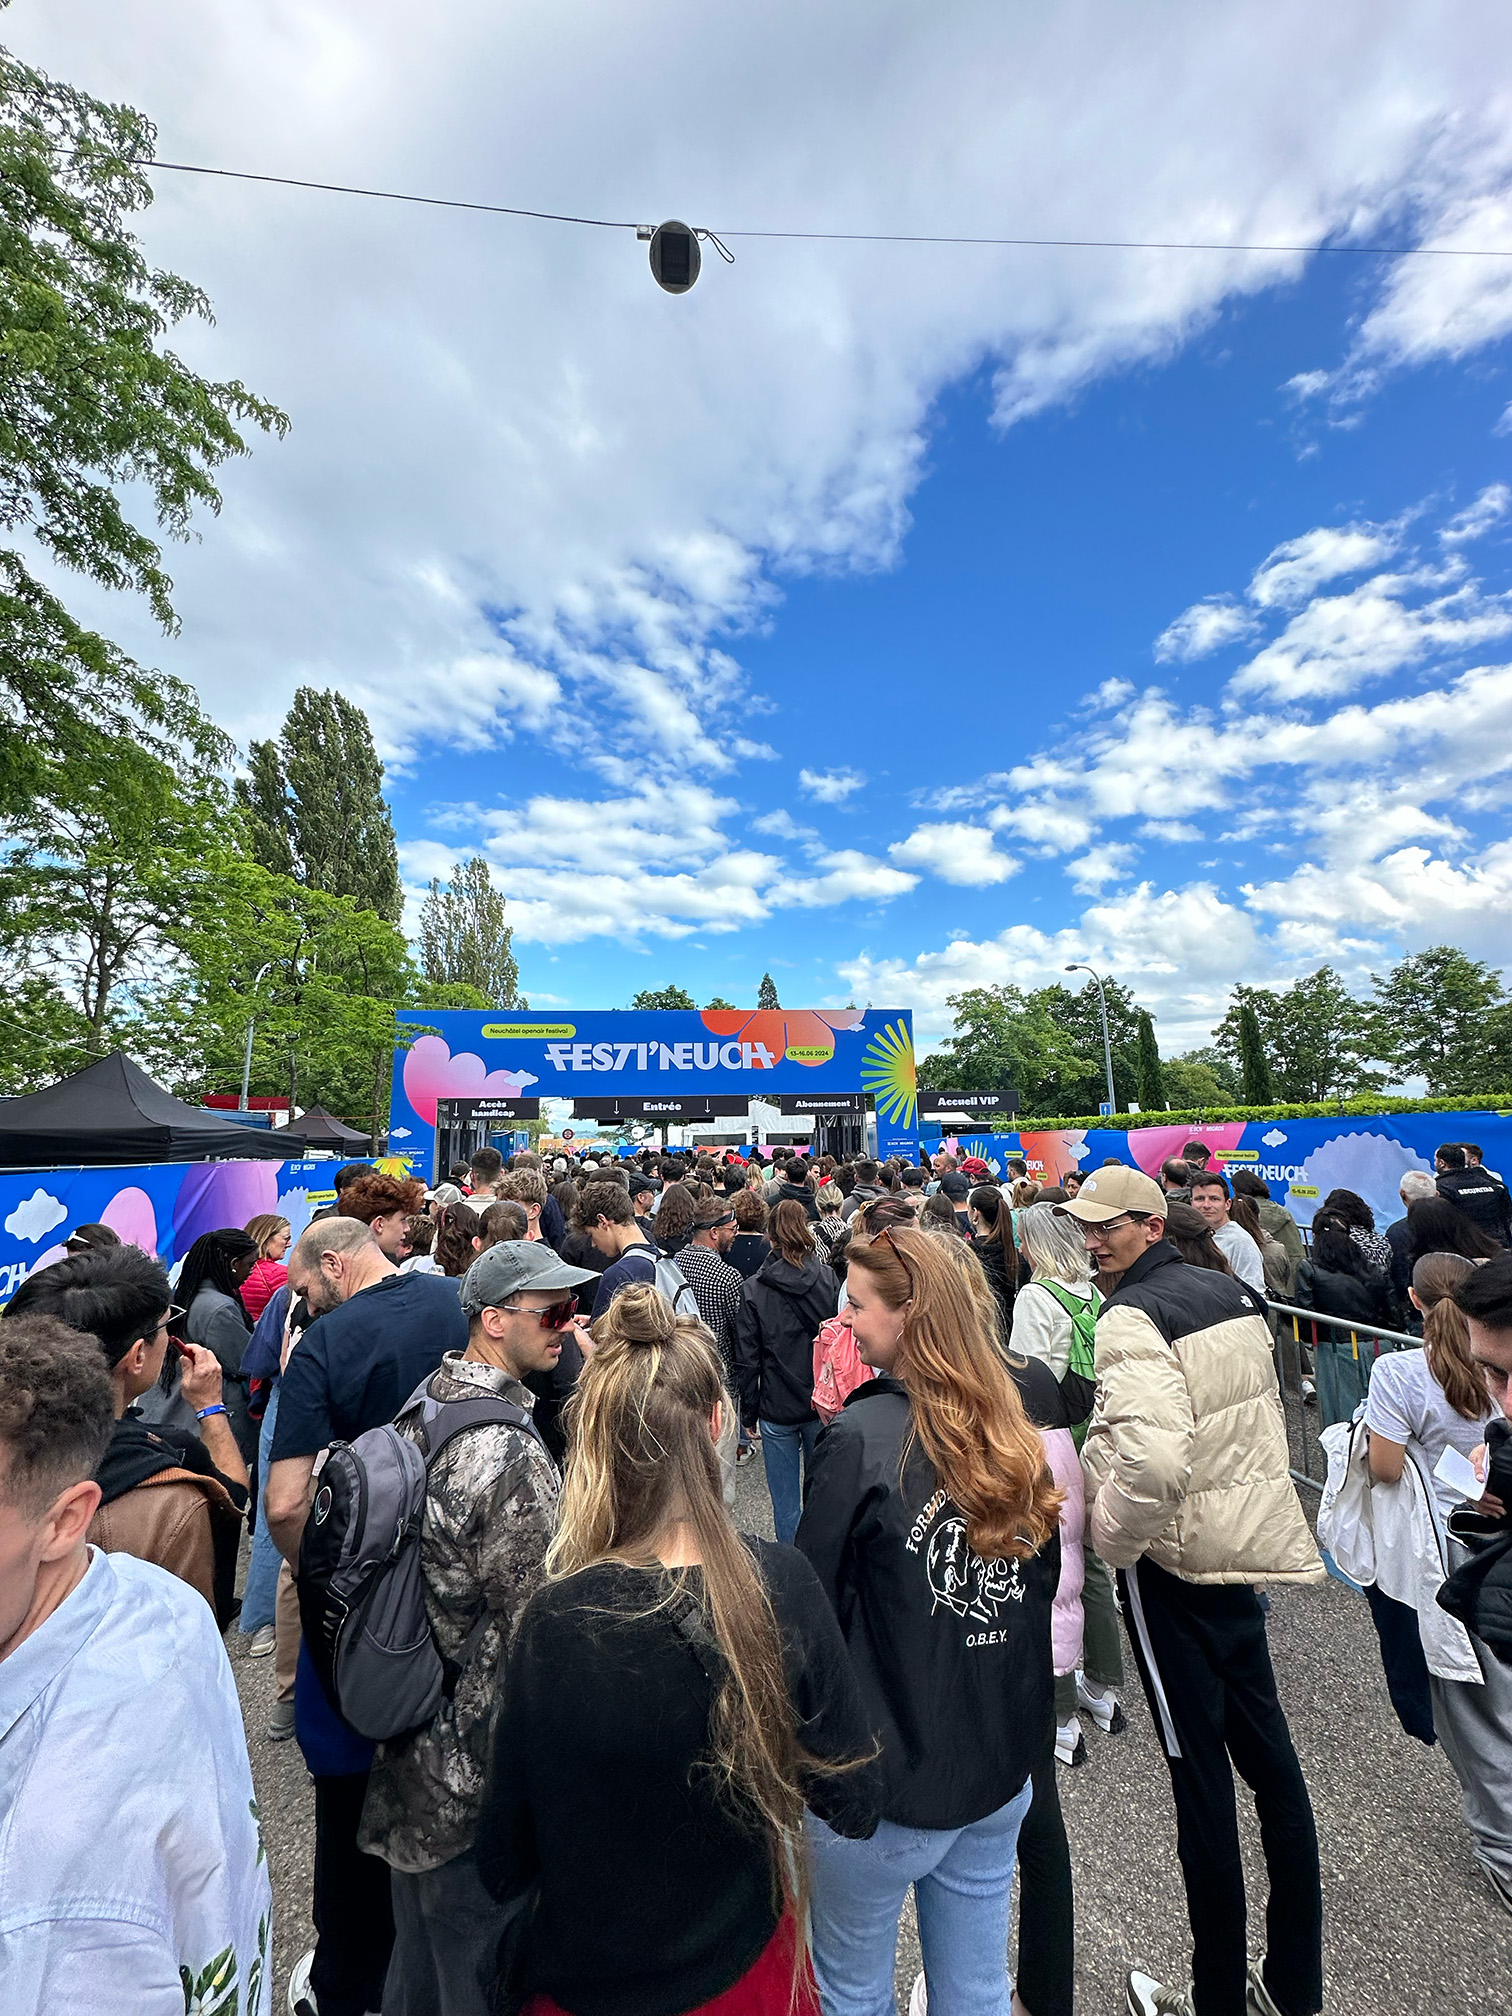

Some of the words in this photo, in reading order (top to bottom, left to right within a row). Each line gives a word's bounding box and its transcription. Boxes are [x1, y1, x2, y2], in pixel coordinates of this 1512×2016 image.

[544, 1041, 775, 1071] FESTI'NEUCH
[478, 1100, 507, 1108] Accès
[643, 1101, 682, 1111] Entrée
[795, 1100, 850, 1108] Abonnement
[937, 1097, 978, 1106] Accueil
[978, 1096, 999, 1105] VIP
[471, 1109, 515, 1118] handicap
[965, 1629, 1008, 1648] O.B.E.Y.
